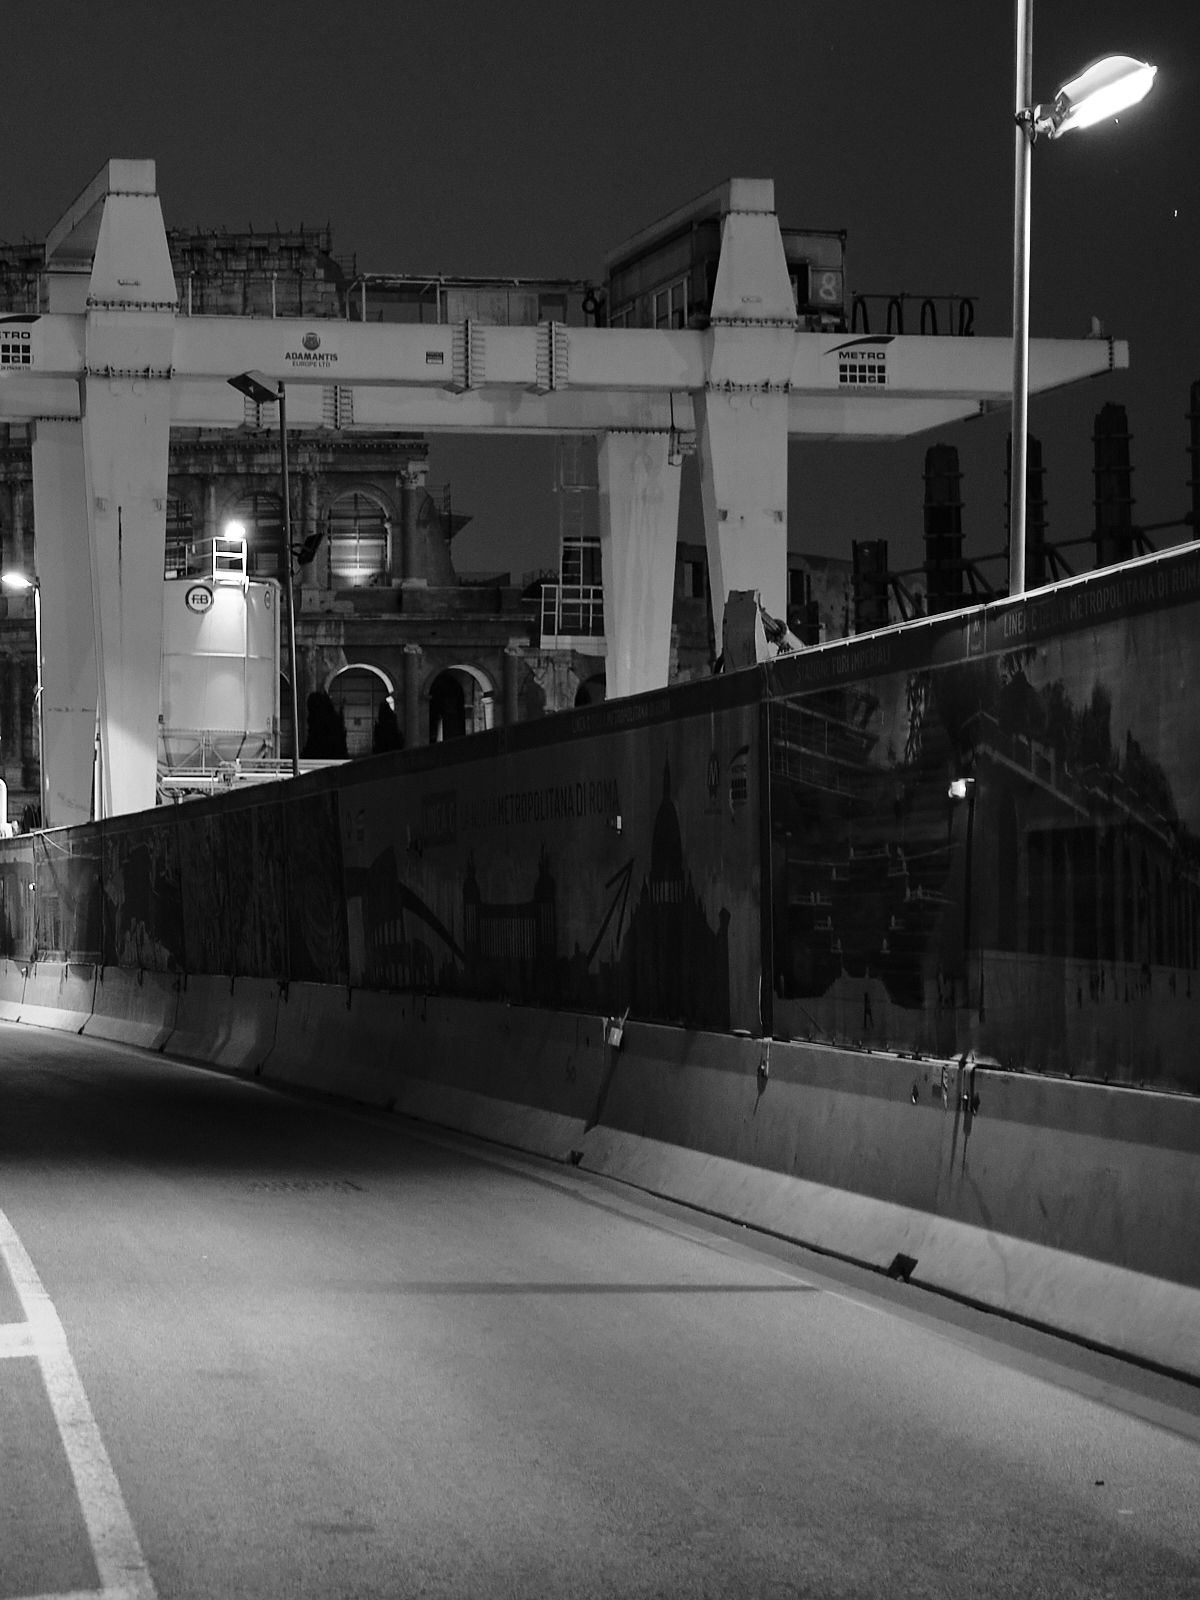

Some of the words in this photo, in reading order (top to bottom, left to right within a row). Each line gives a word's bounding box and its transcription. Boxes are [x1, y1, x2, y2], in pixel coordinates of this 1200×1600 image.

[284, 352, 338, 361] ADAMANTIS
[839, 352, 885, 360] METRO
[1070, 575, 1156, 620] METROPOLITANA
[1157, 570, 1169, 600] DI
[497, 786, 574, 825] METROPOLITANA
[576, 782, 586, 817] DI
[589, 778, 620, 814] ROMA
